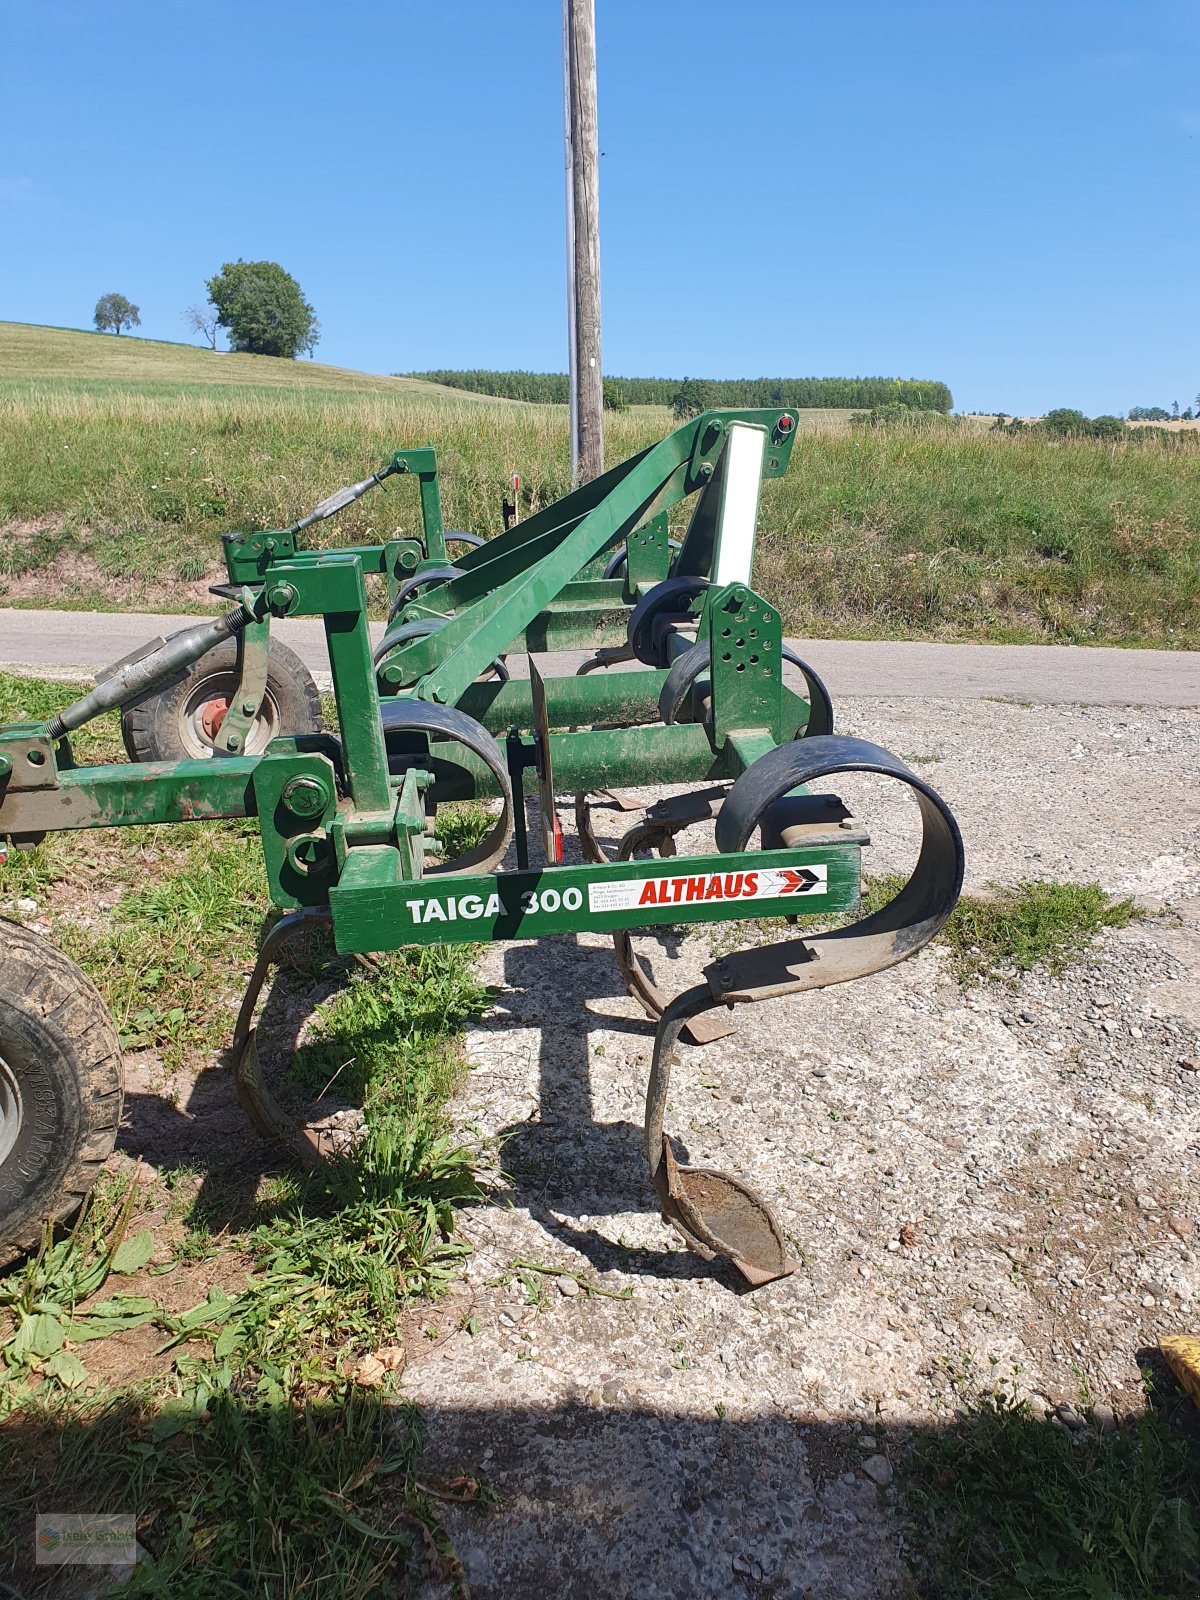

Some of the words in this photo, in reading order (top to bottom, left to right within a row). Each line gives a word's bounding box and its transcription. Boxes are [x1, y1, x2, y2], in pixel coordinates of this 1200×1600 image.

[406, 893, 508, 924] TAIGA
[520, 887, 583, 915] 300
[638, 872, 759, 905] ALTHAUS
